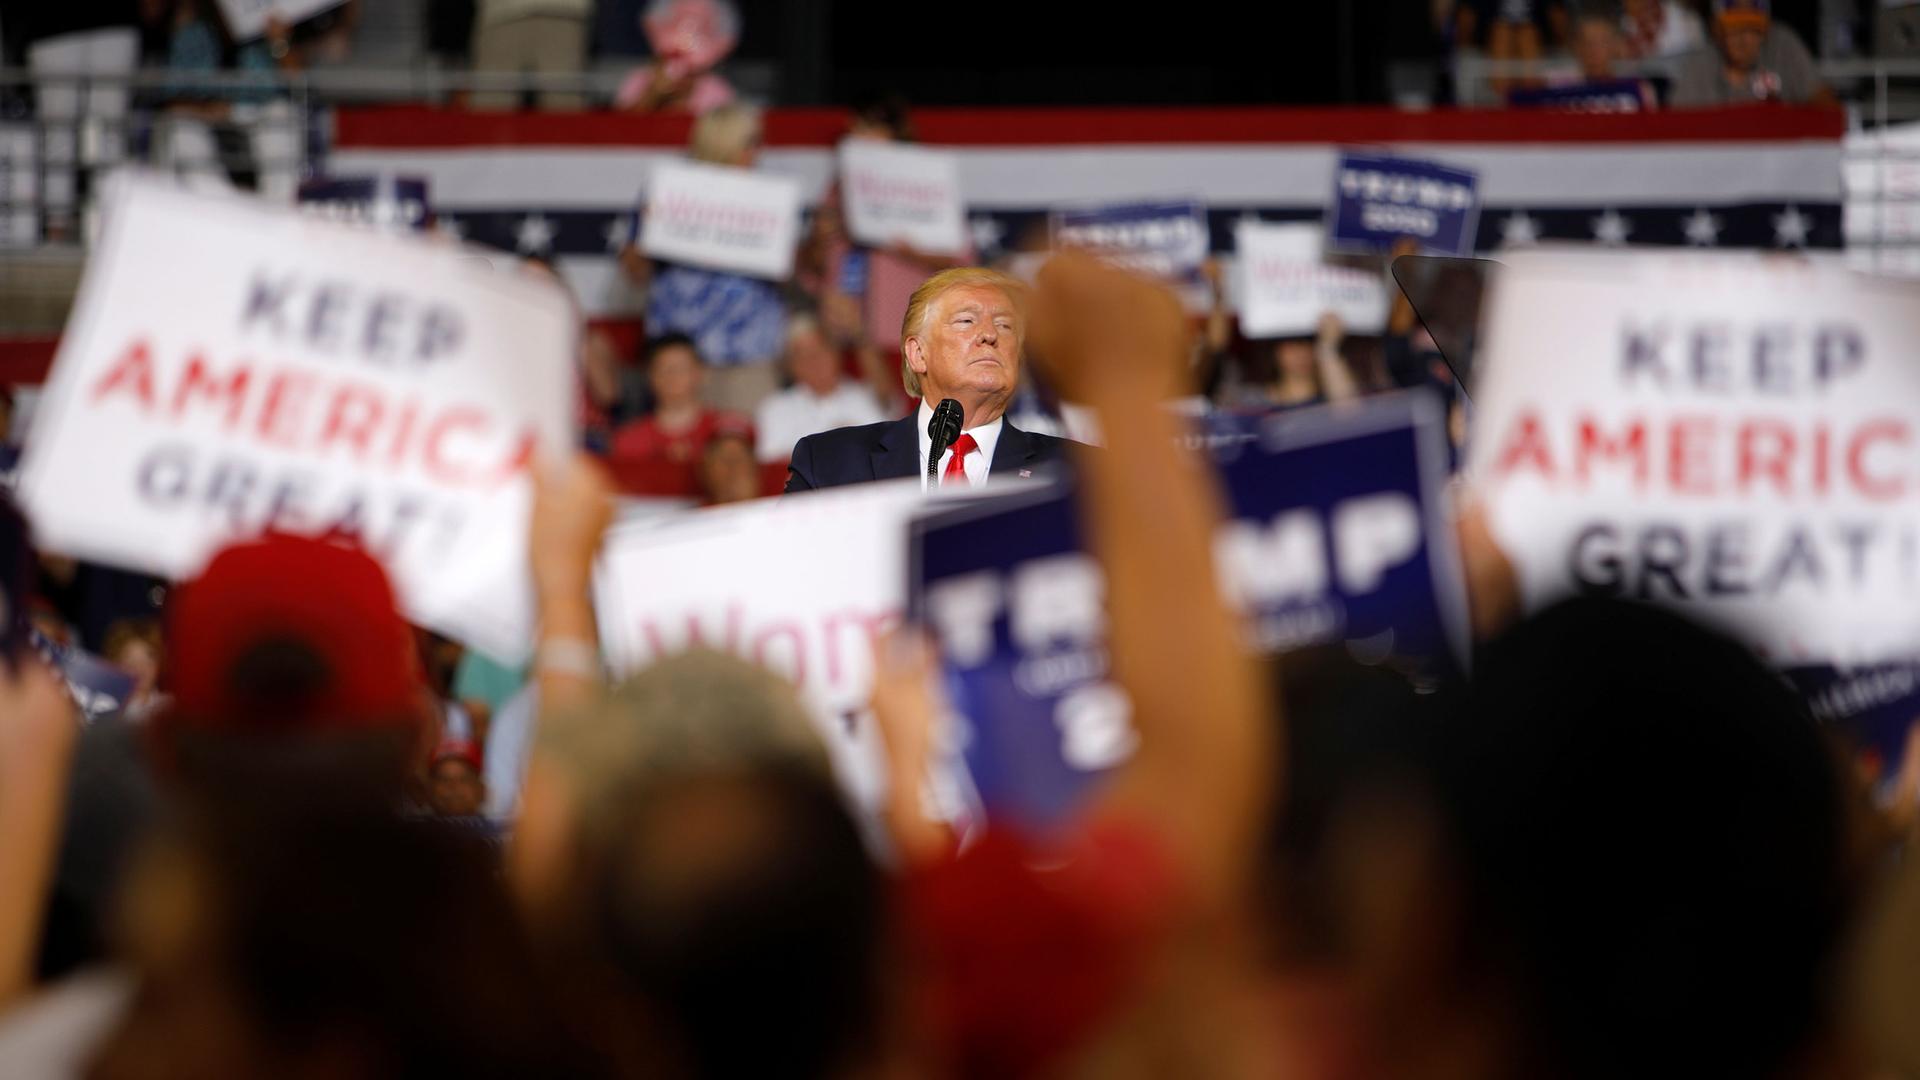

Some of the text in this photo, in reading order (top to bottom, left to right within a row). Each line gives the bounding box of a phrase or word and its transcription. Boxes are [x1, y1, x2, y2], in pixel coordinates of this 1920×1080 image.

[242, 264, 468, 366] KEEP
[1619, 316, 1866, 393] KEEP
[930, 494, 1422, 670] TRMP
